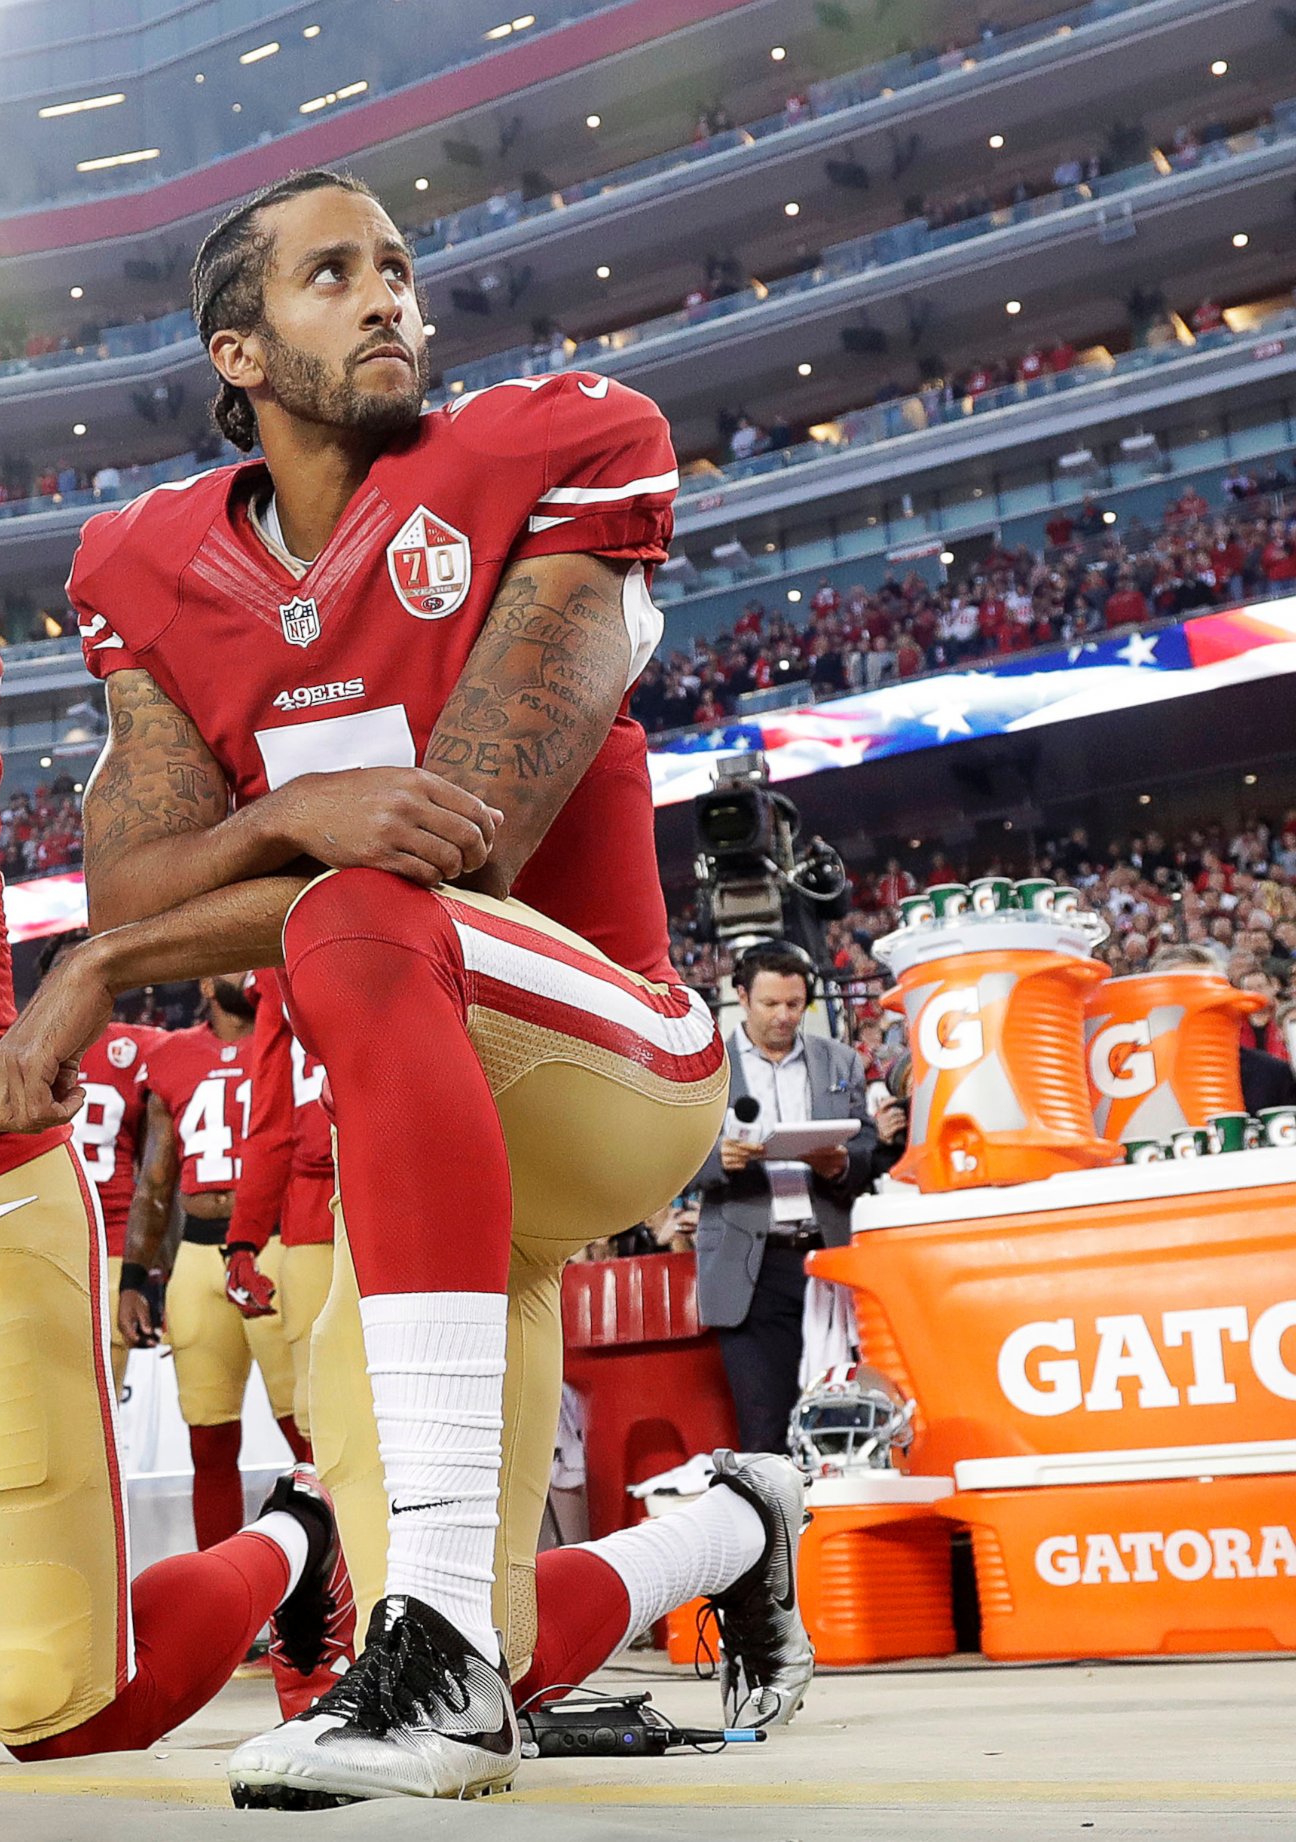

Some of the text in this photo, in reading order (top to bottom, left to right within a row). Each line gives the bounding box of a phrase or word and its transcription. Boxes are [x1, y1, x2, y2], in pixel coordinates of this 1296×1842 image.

[403, 550, 454, 586] 70
[288, 617, 315, 639] NFL
[272, 678, 365, 711] 49ERS
[919, 986, 984, 1069] G
[1091, 1019, 1157, 1098] G
[1035, 1526, 1296, 1586] GATORA
